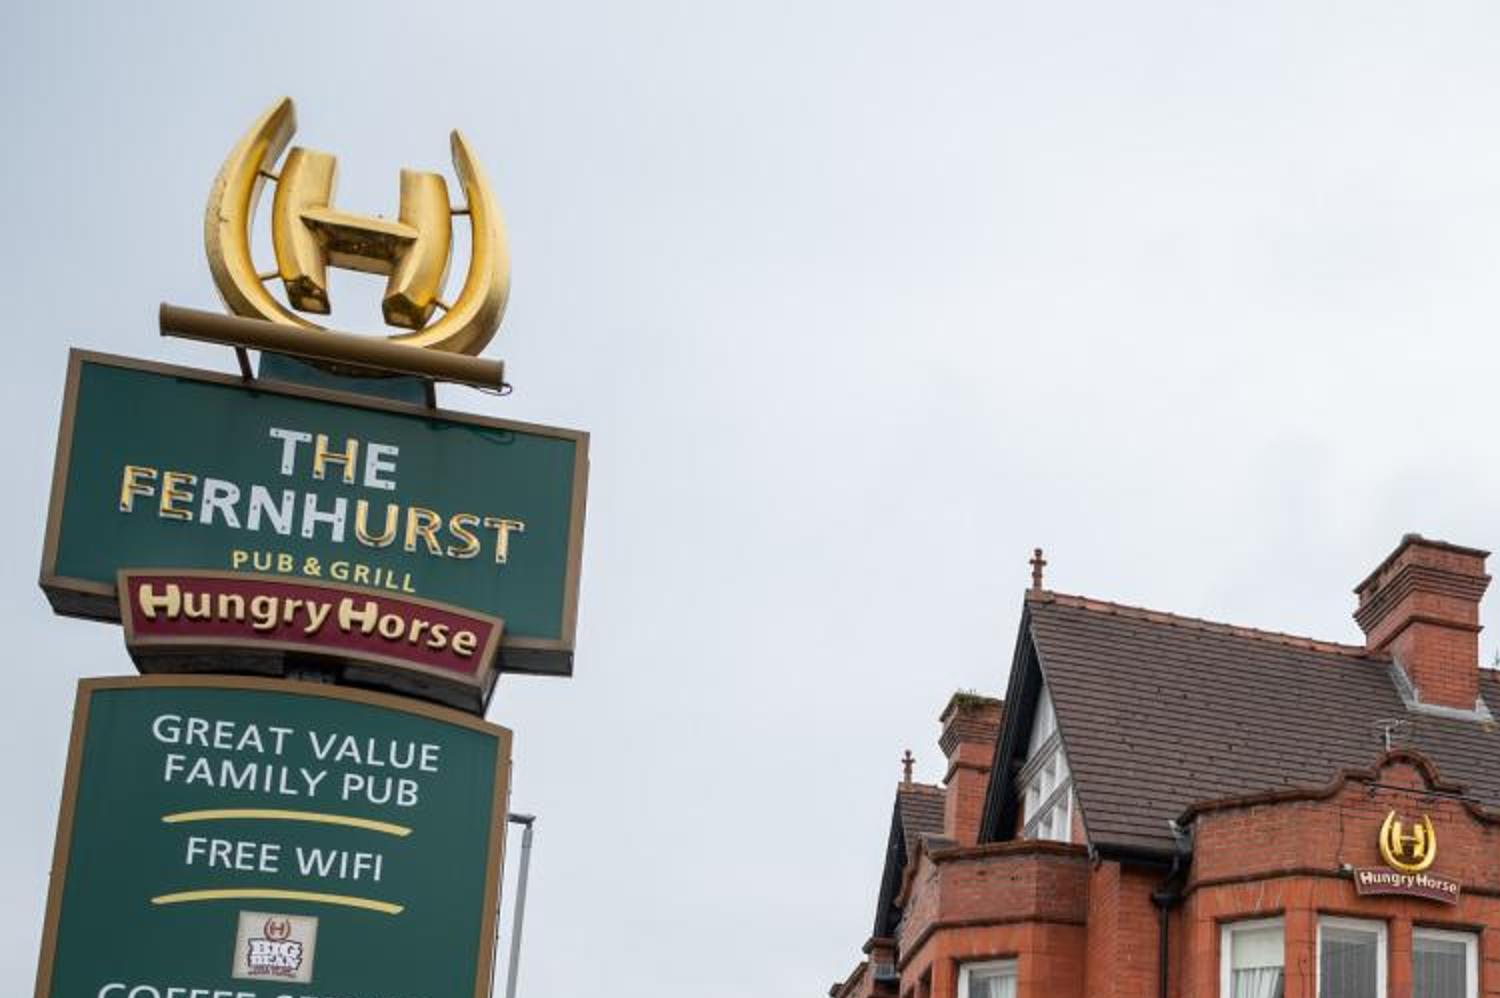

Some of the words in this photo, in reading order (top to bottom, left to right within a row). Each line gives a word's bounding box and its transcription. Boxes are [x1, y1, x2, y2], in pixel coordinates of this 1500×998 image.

[269, 427, 400, 491] THE
[118, 464, 526, 565] FERNHURST
[232, 549, 294, 574] PUB
[303, 556, 321, 577] &
[330, 560, 417, 594] GRILL
[152, 714, 294, 756] GREAT
[308, 731, 442, 773] VALUE
[164, 754, 328, 798] FAMILY
[341, 773, 419, 807] PUB
[185, 837, 281, 873] FREE
[296, 847, 384, 882] WIFI
